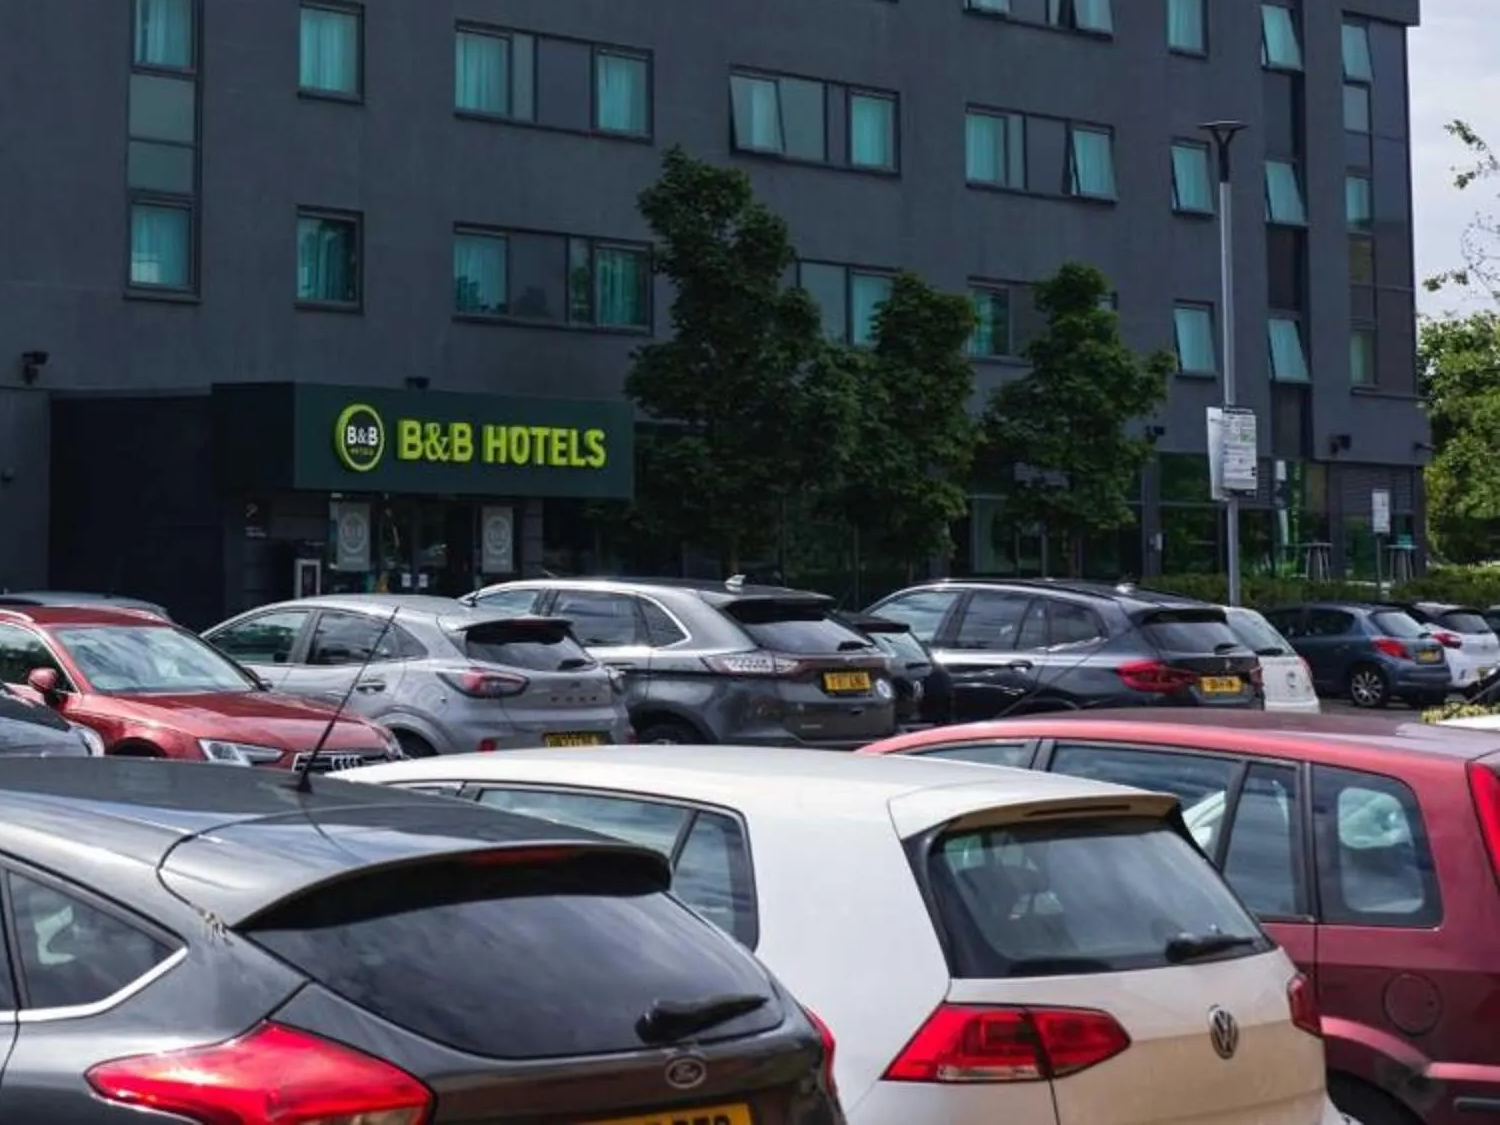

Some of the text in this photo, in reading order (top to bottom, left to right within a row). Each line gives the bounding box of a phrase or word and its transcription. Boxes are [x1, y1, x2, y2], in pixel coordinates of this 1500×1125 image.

[347, 425, 378, 445] B&B
[397, 419, 606, 468] B&B HOTELS
